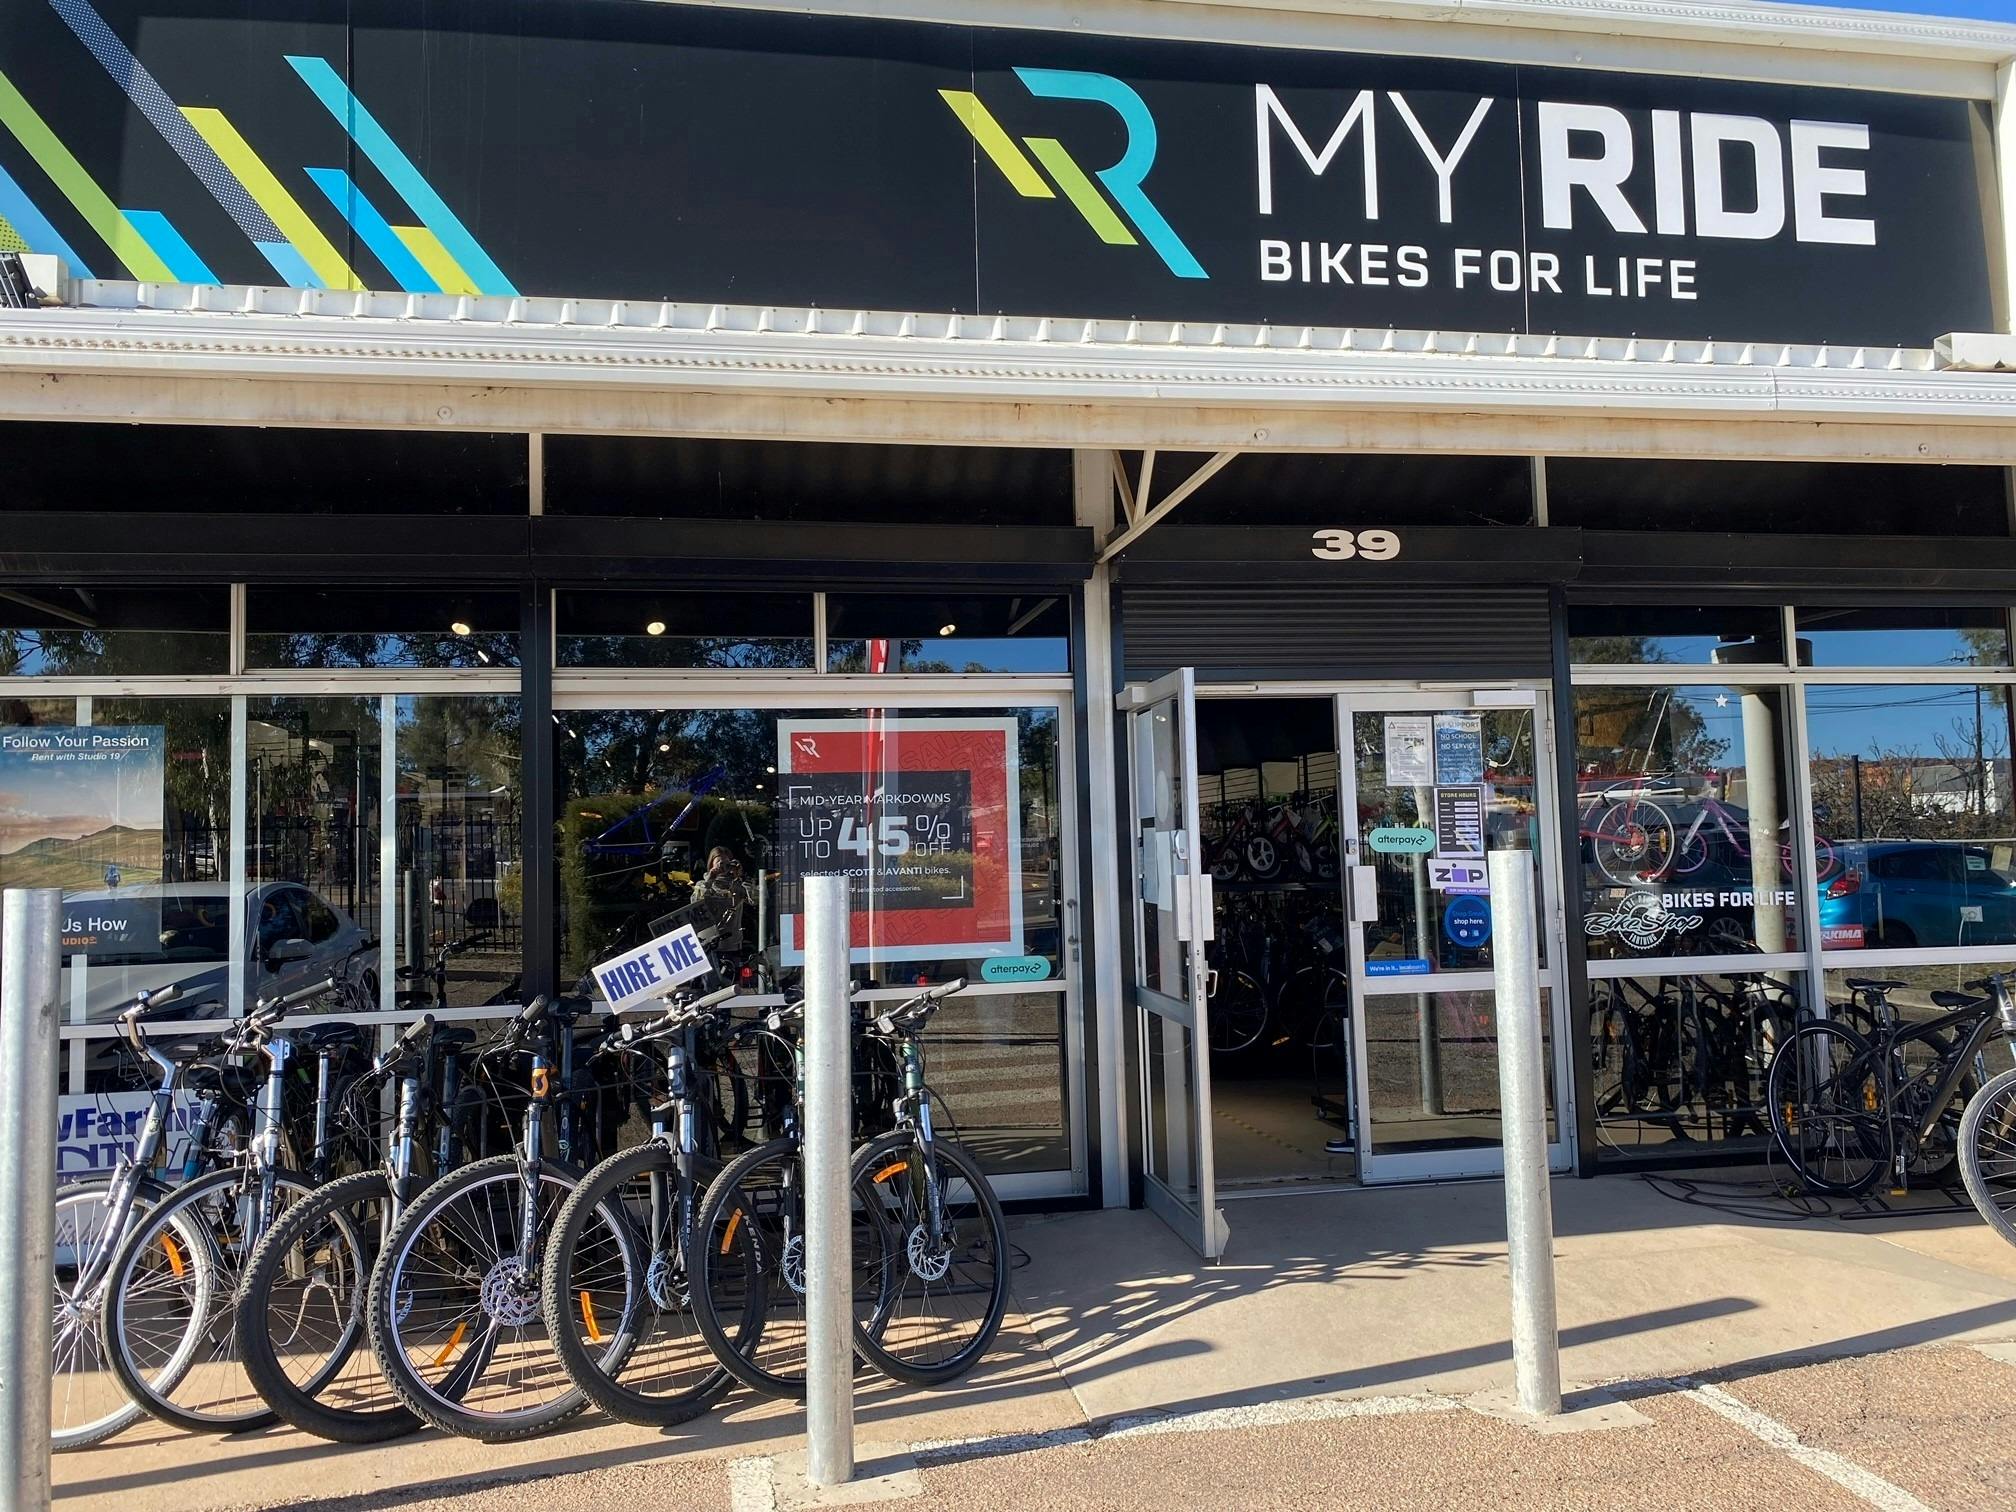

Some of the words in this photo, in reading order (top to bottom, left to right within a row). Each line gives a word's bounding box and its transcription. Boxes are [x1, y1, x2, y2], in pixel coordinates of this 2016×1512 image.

[1255, 82, 1495, 223] MY
[1537, 101, 1877, 246] RIDE
[1260, 238, 1429, 286] BIKES
[1454, 247, 1562, 295] FOR
[1586, 254, 1698, 301] LIFE
[1311, 528, 1401, 561] 39
[2, 736, 50, 748] Follow
[55, 736, 88, 748] Your
[92, 735, 149, 747] Passion
[31, 753, 54, 761] Rent
[56, 752, 75, 761] with
[78, 752, 107, 761] Studio
[110, 752, 121, 761] 19
[800, 795, 862, 806] MID-YEAR
[867, 793, 951, 805] MARKDOWNS
[800, 818, 832, 838] UP
[1377, 834, 1416, 846] afterpay
[799, 839, 831, 859] TO
[915, 841, 951, 857] OFF
[800, 869, 841, 879] selected
[843, 868, 874, 877] SCOTT
[876, 868, 884, 876] &
[885, 867, 922, 876] AVANTI
[924, 866, 951, 875] bikes.
[1662, 892, 1715, 909] BIKES
[1719, 891, 1754, 908] FOR
[1757, 891, 1796, 906] LIFE
[88, 917, 128, 932] How
[600, 953, 662, 1002] HIRE
[657, 933, 704, 976] ME
[990, 964, 1031, 975] afterpay
[742, 1214, 763, 1274] KENDA
